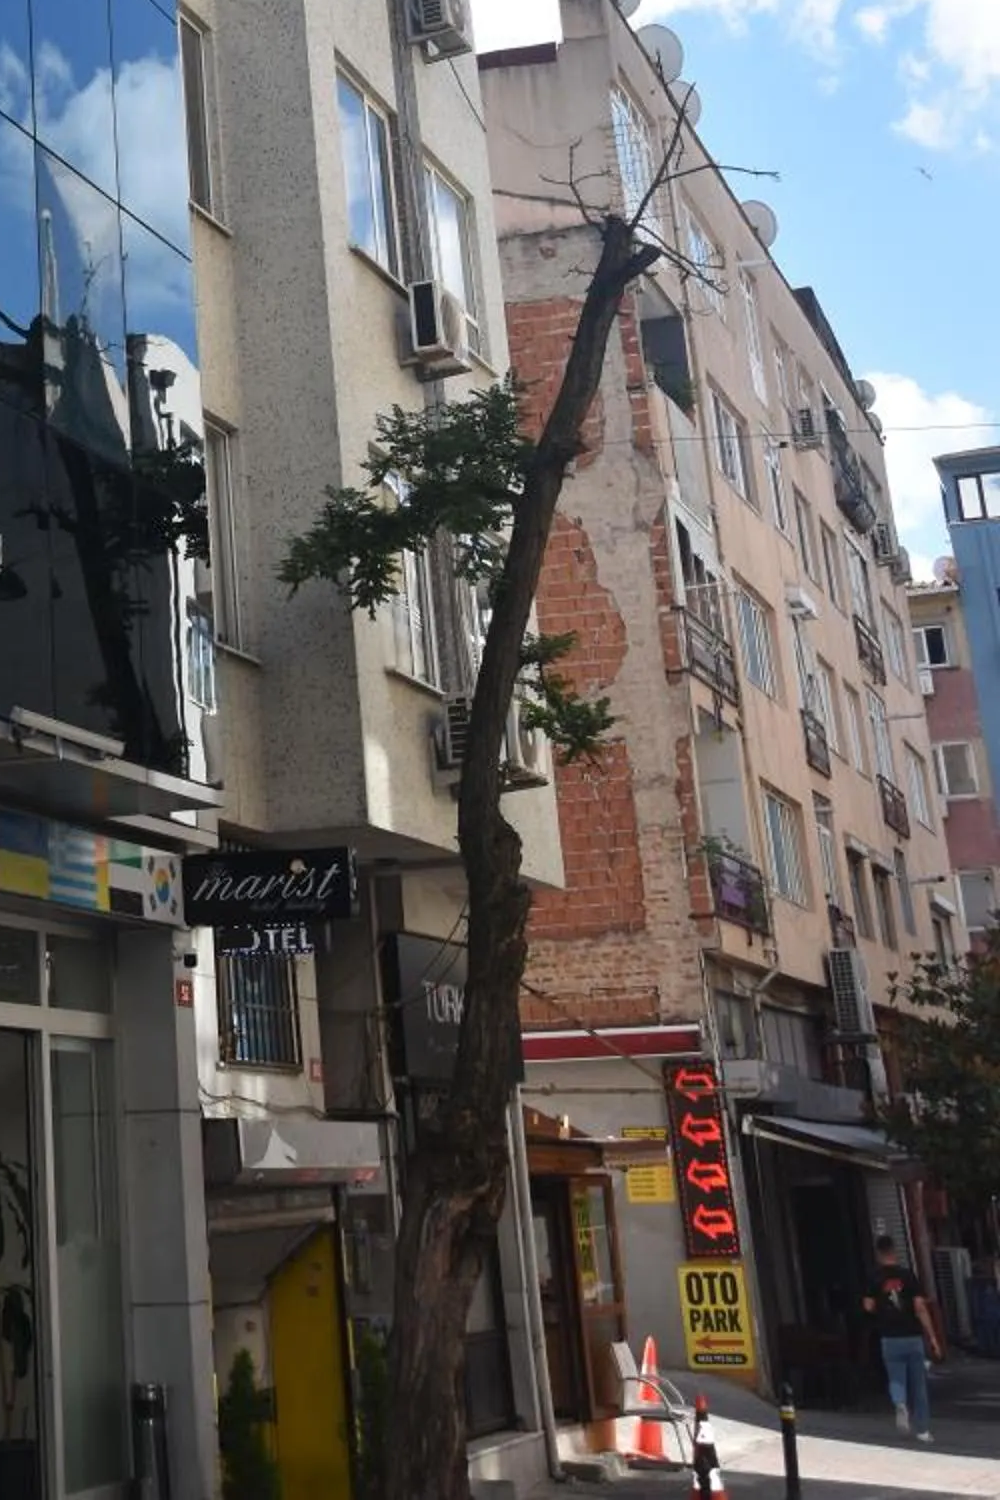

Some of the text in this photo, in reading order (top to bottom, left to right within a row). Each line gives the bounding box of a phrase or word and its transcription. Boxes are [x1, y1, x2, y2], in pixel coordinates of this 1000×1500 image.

[191, 860, 343, 902] marist
[686, 1271, 739, 1306] OTO
[690, 1308, 743, 1333] PARK
